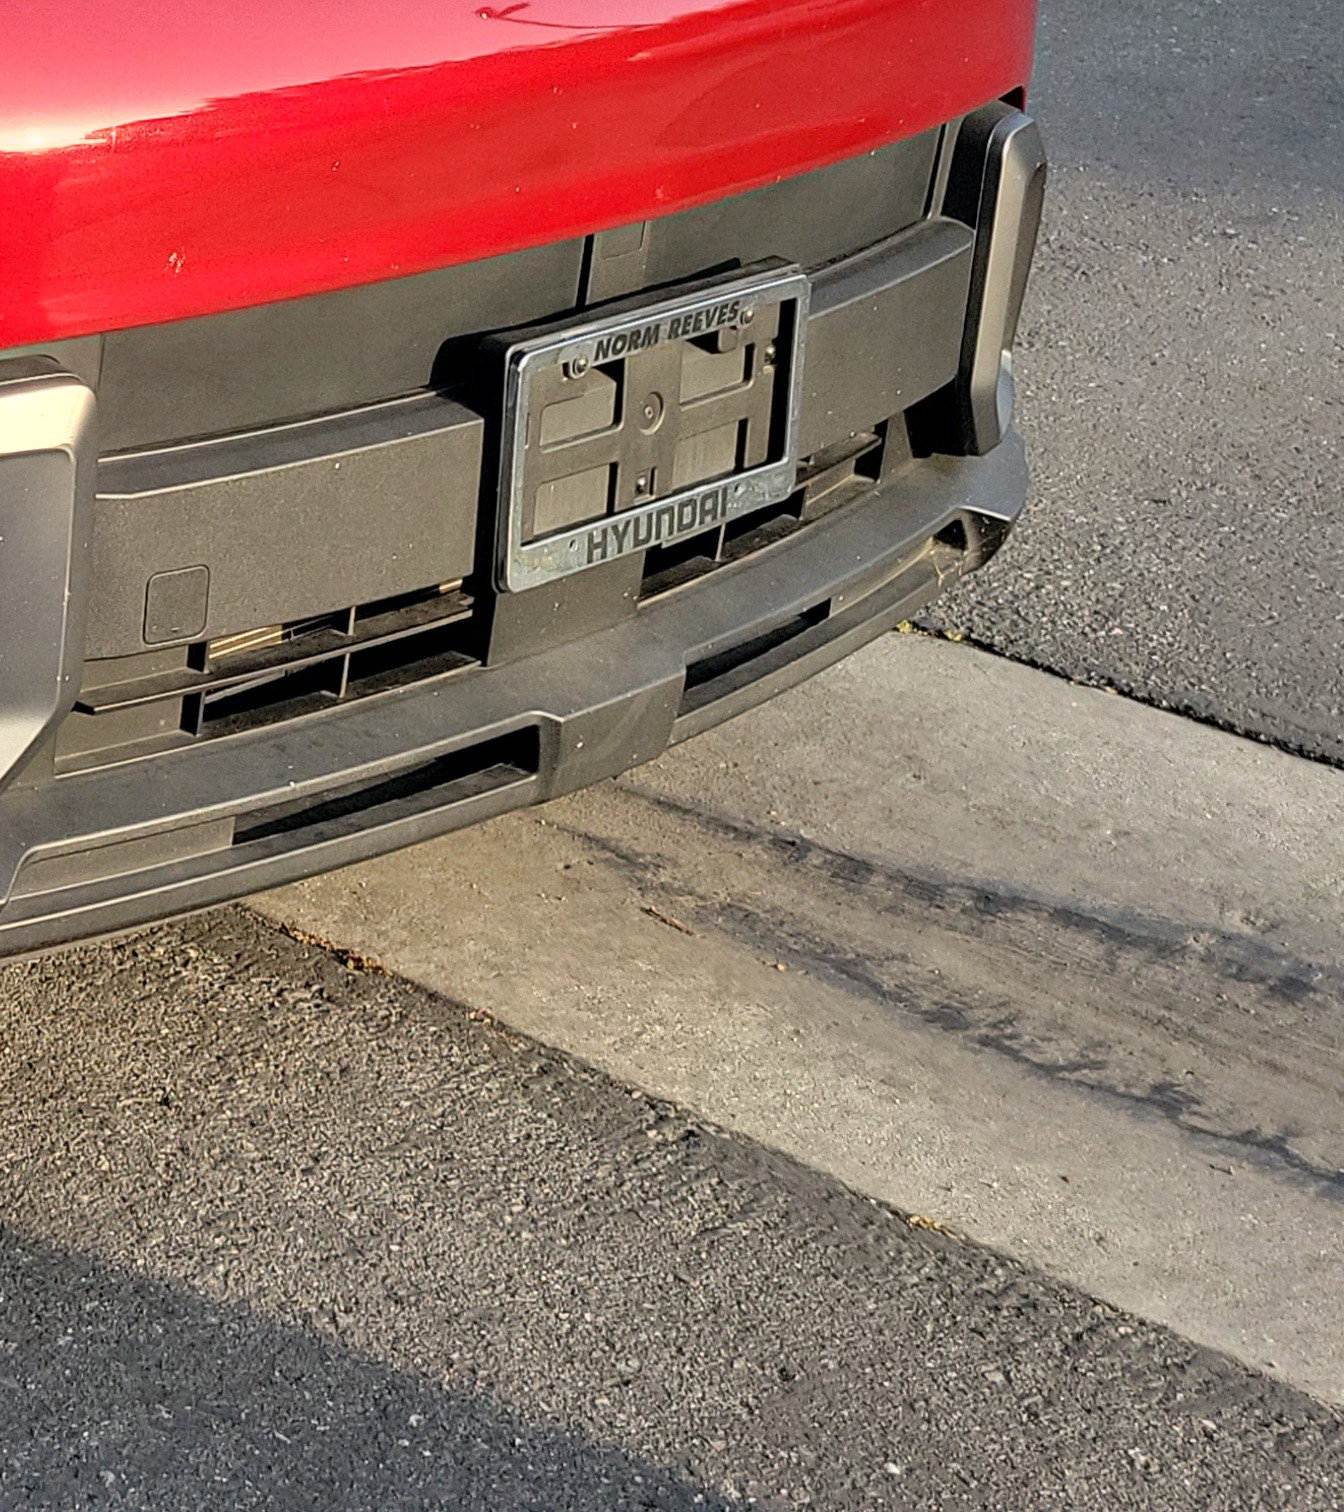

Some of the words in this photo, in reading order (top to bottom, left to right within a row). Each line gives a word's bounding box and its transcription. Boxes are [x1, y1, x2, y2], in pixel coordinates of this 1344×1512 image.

[593, 323, 661, 361] NORM
[667, 300, 742, 340] REEVES
[586, 485, 729, 565] HYUNDAI
